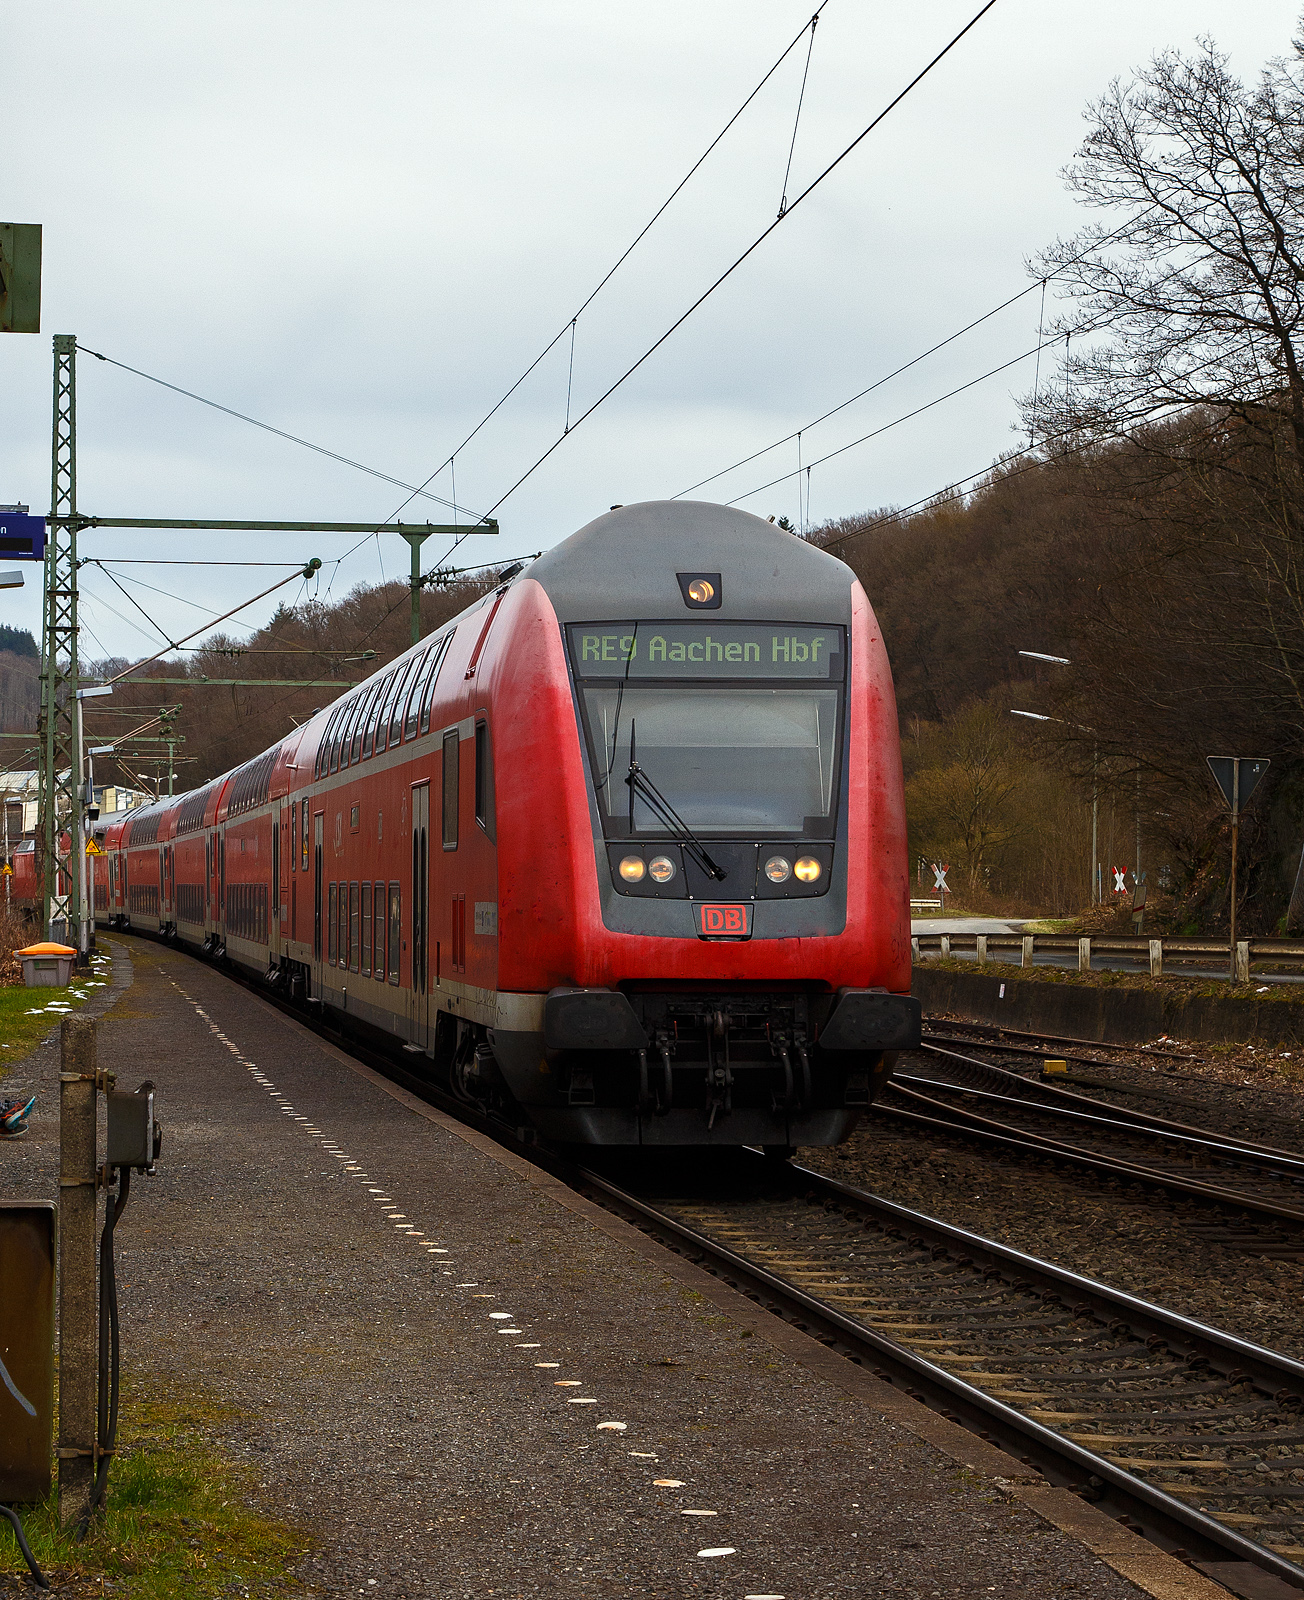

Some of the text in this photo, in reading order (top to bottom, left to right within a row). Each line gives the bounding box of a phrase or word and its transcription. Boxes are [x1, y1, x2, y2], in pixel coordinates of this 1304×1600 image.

[582, 635, 825, 662] RE9 Aachen Hbf
[706, 909, 742, 930] DB
